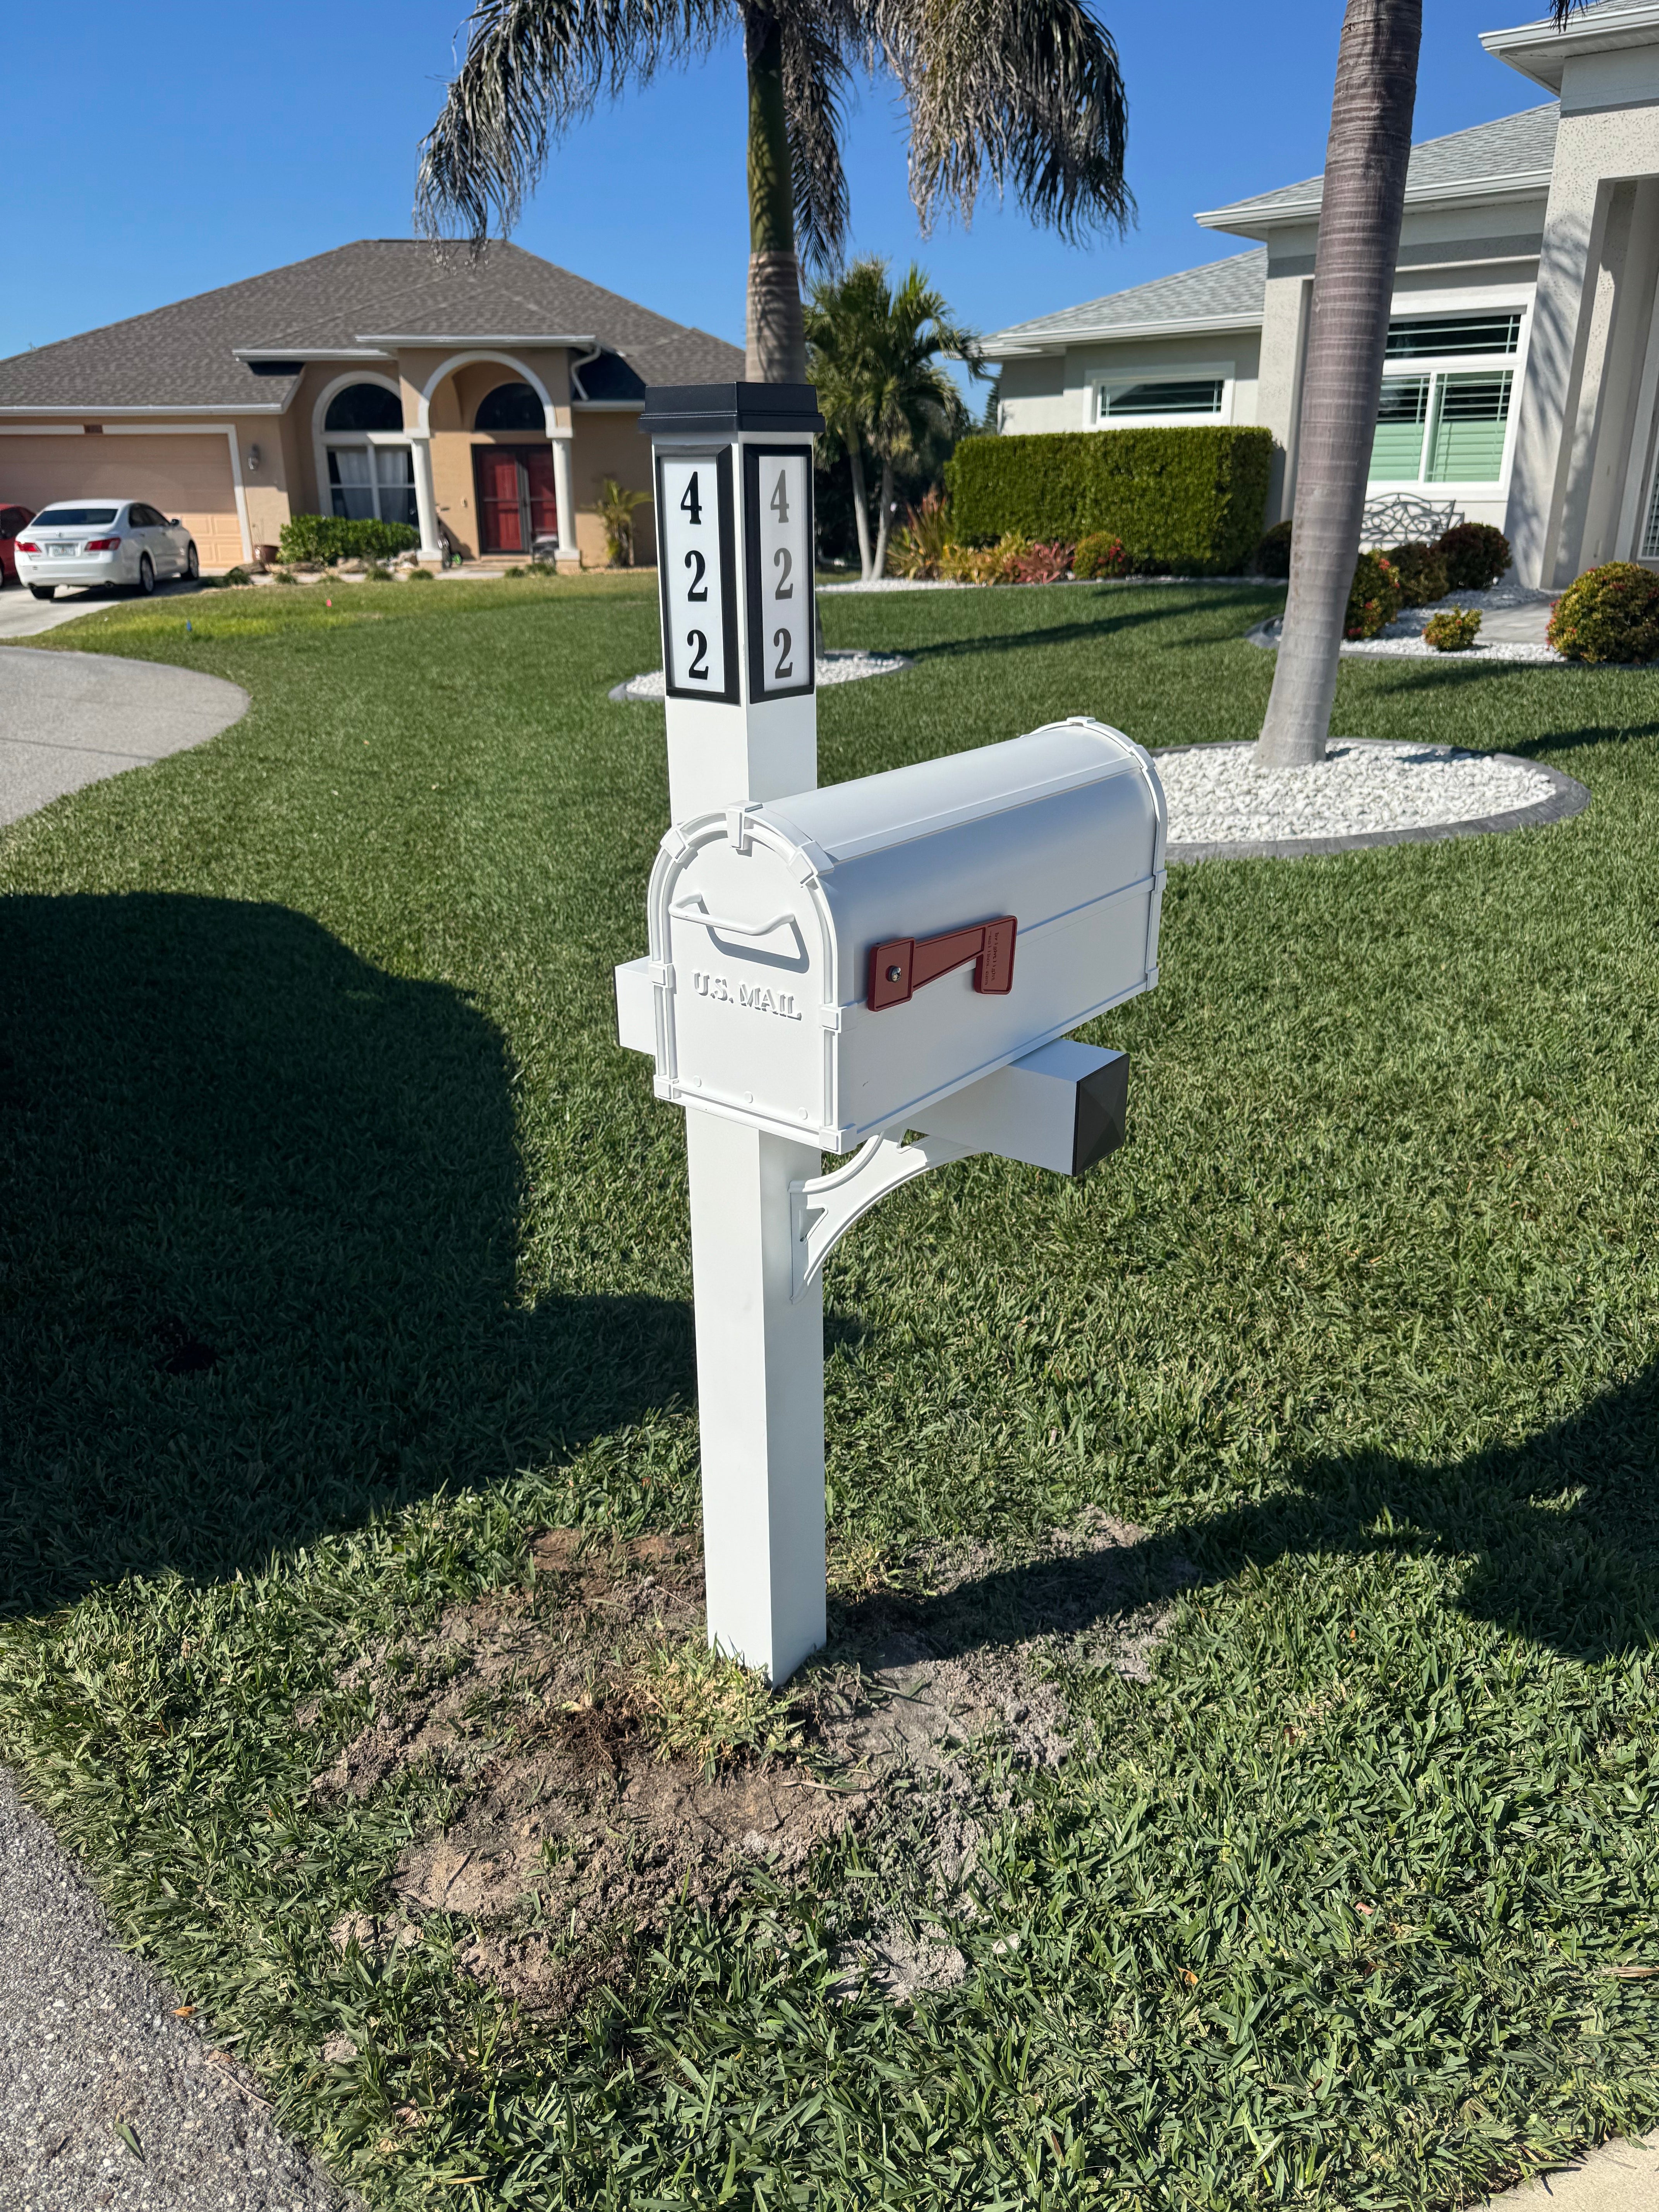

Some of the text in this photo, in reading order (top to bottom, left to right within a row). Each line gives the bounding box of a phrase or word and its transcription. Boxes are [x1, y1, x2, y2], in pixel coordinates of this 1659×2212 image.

[680, 471, 709, 681] 422
[770, 469, 793, 680] 422
[691, 969, 802, 1021] U.S. MAIL
